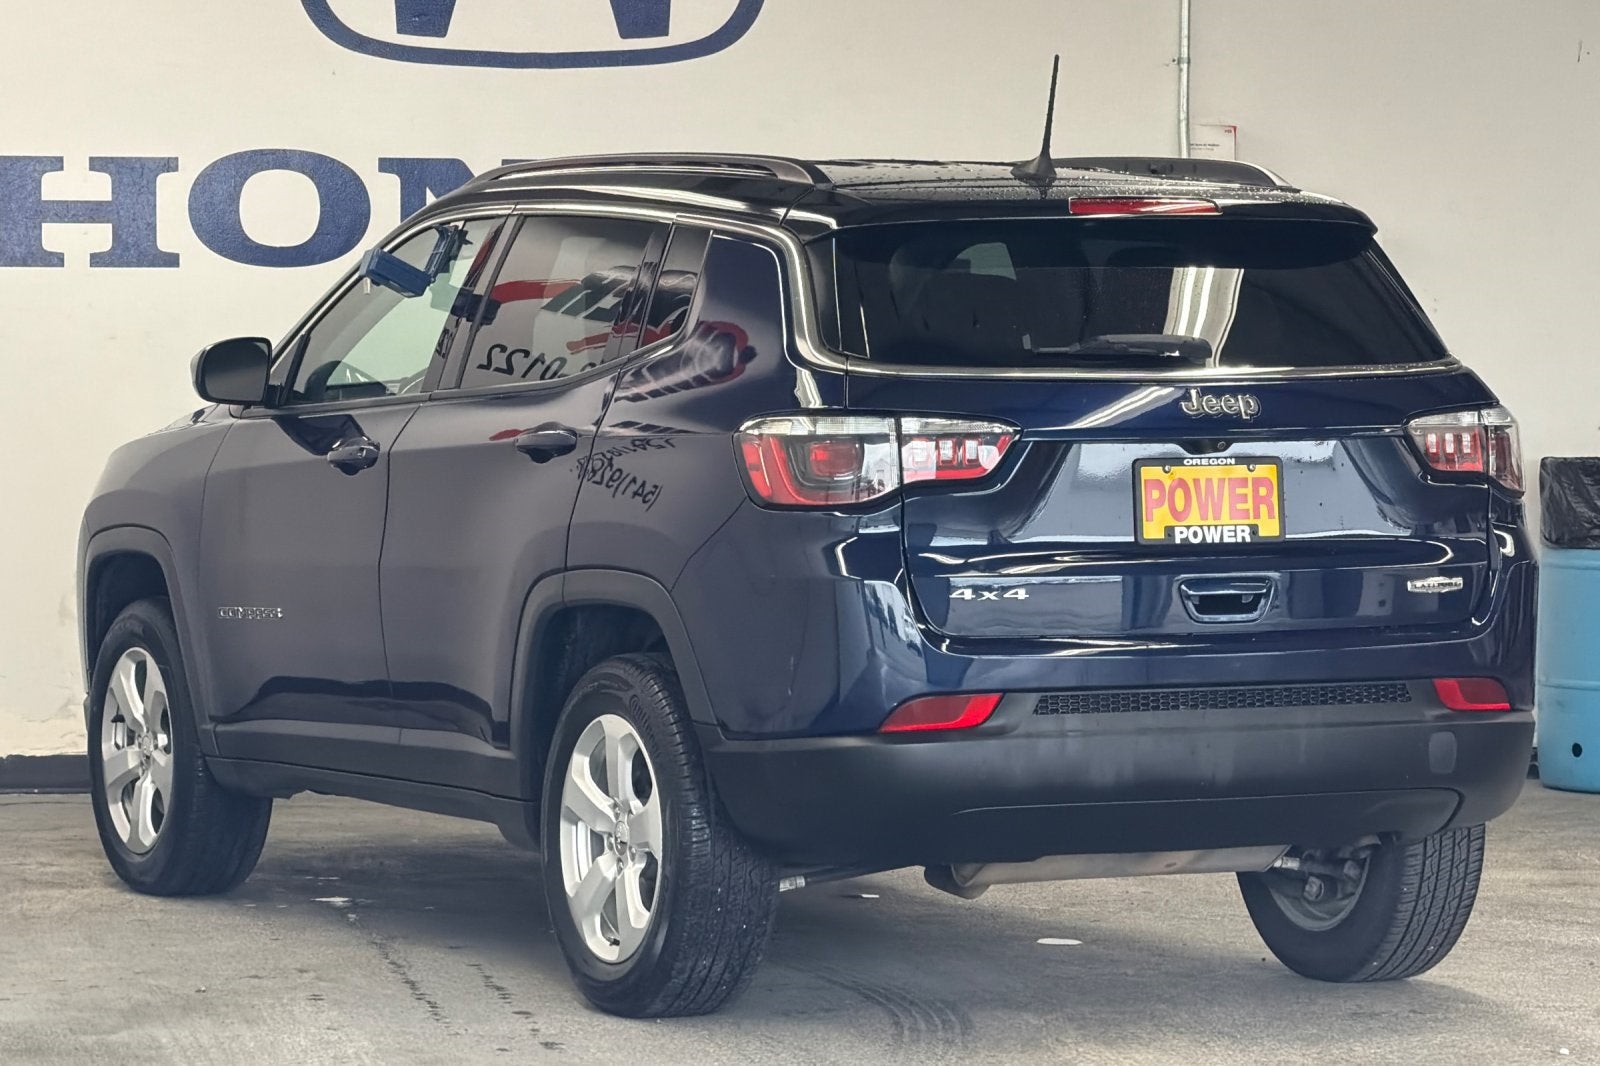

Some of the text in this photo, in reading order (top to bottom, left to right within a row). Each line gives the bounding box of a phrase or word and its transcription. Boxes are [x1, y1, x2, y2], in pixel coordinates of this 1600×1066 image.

[1179, 388, 1261, 420] Jeep
[1183, 457, 1236, 466] OREGON
[1143, 476, 1276, 523] POWER
[1174, 525, 1252, 544] POWER
[948, 587, 1030, 600] 4x4
